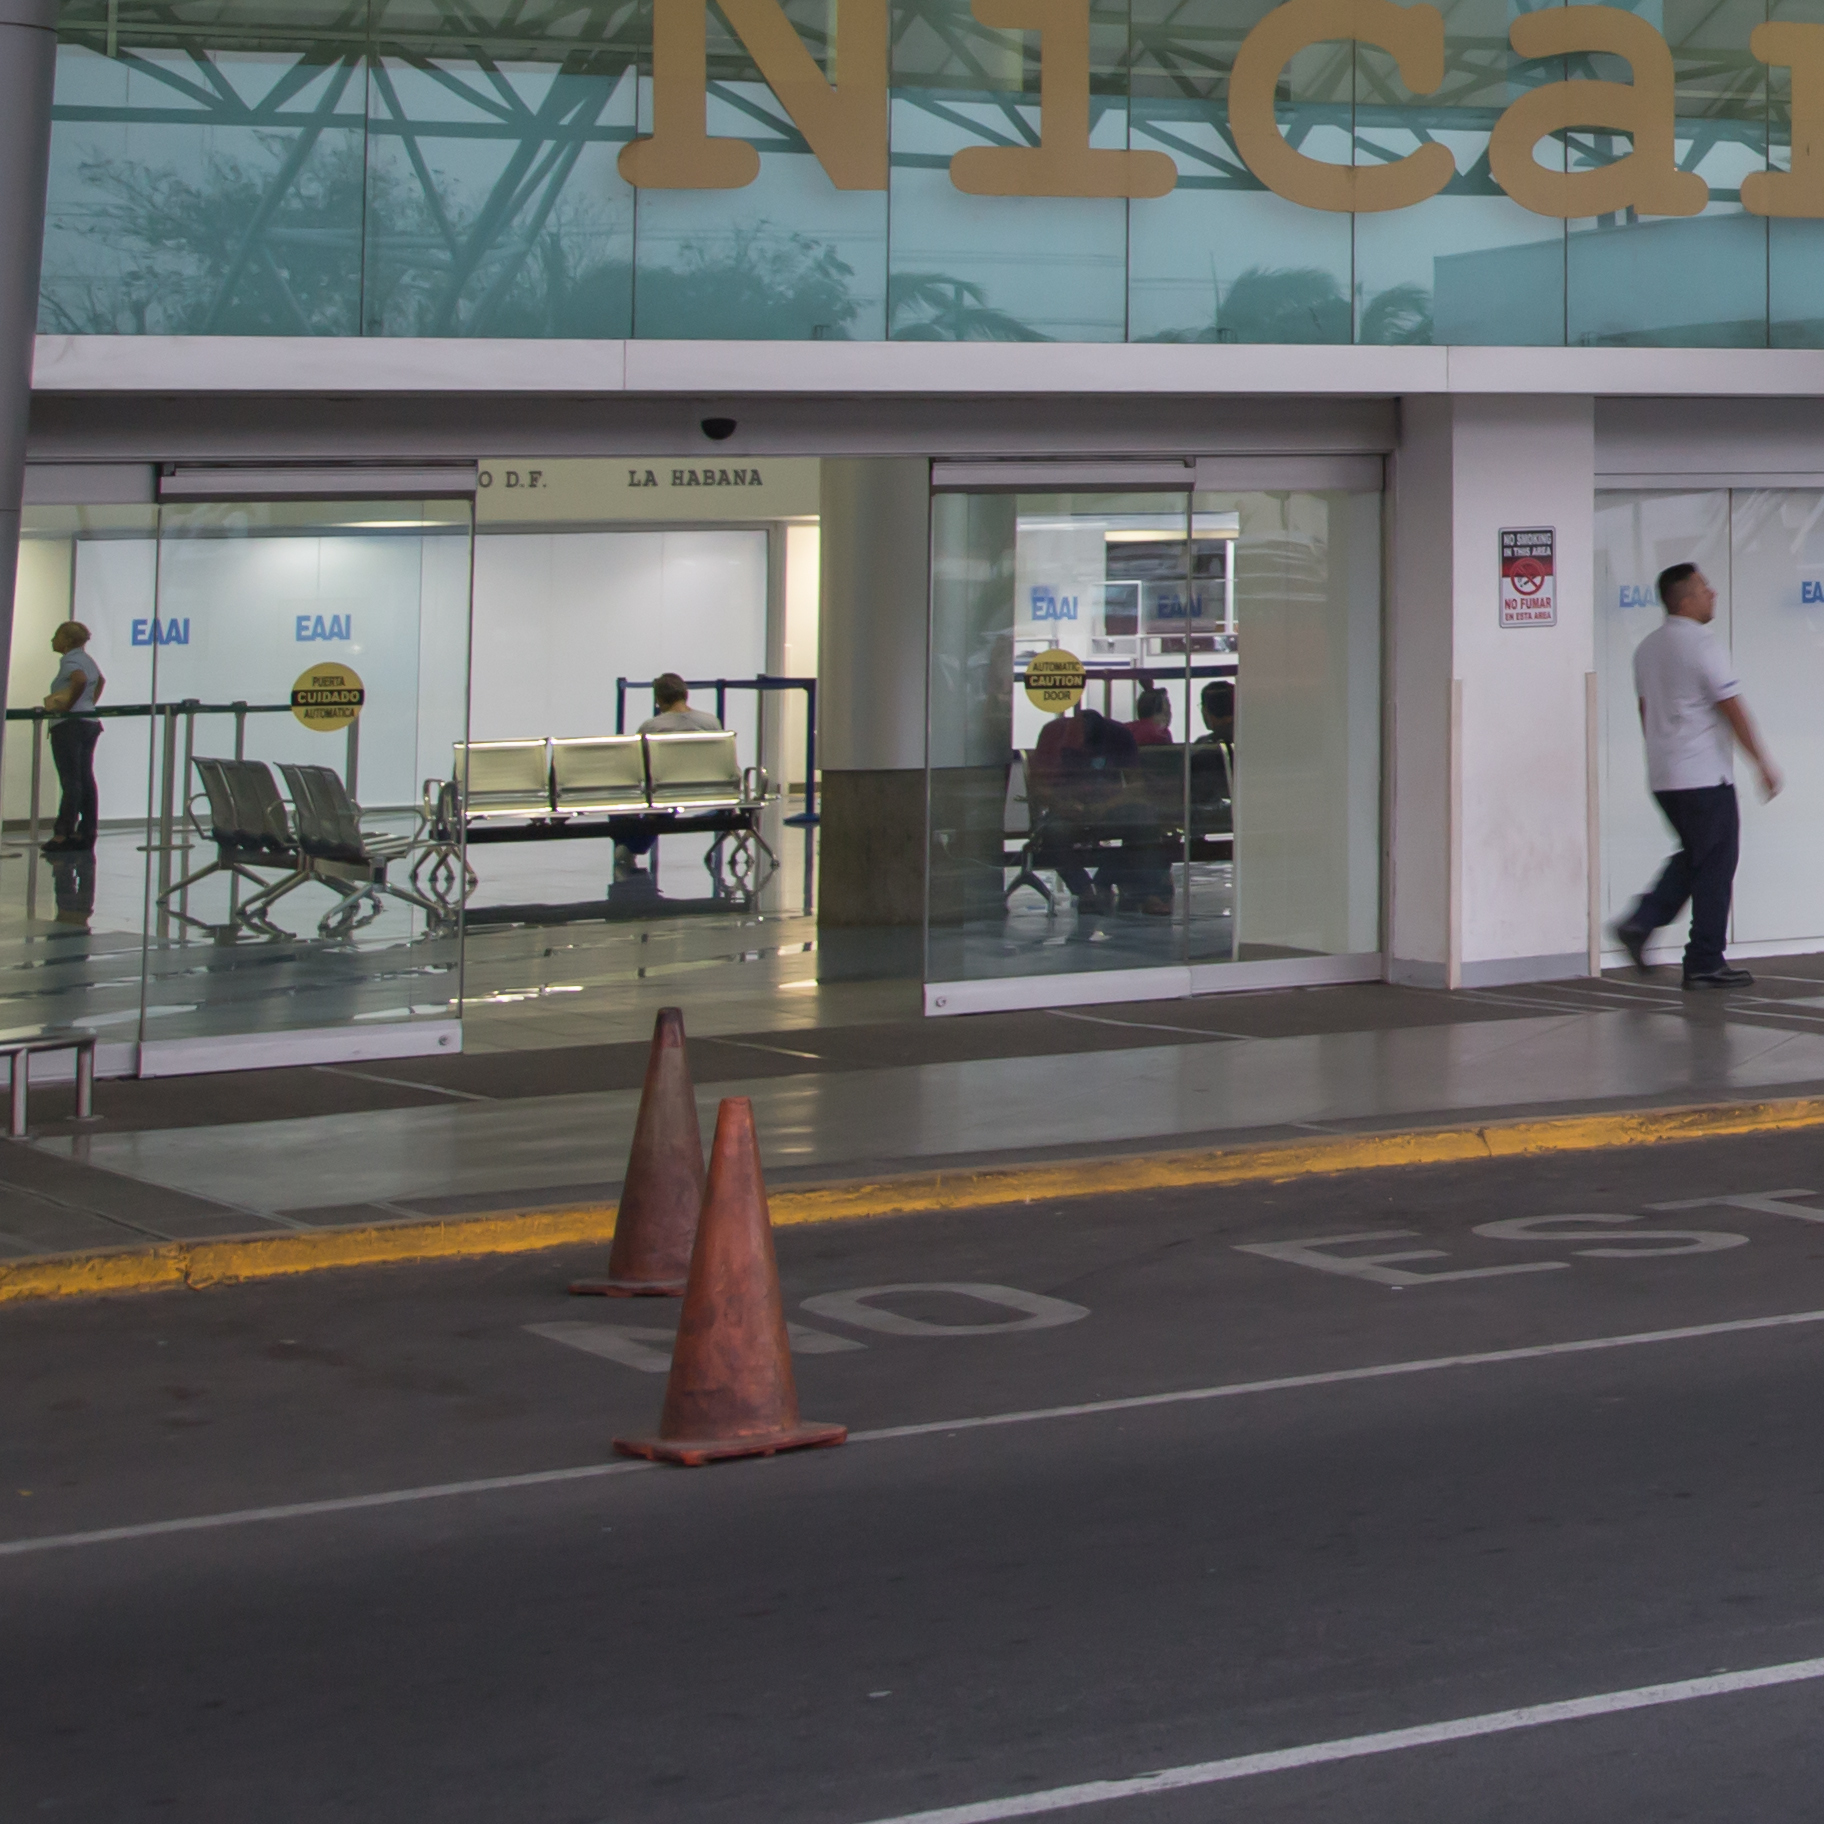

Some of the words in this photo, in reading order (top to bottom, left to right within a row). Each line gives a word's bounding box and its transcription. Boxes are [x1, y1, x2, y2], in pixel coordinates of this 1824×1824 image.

[505, 470, 548, 489] D.F.
[628, 469, 658, 488] LA
[671, 468, 763, 487] HABANA
[1504, 533, 1515, 546] NO
[1516, 532, 1552, 546] SMOKING
[1504, 547, 1512, 557] IN
[1514, 547, 1530, 557] THIS
[1532, 546, 1551, 556] AREA
[1031, 595, 1079, 621] EAAI
[1505, 598, 1517, 610] NO
[1520, 597, 1552, 609] FUMAR
[131, 618, 190, 646] EAAI
[296, 614, 351, 642] EAAI
[1032, 661, 1080, 672] AUTOMATIC
[312, 676, 346, 687] PUERTA
[1029, 674, 1083, 687] CAUTION
[297, 690, 360, 704] CUIDADO
[1043, 690, 1071, 701] DOOR
